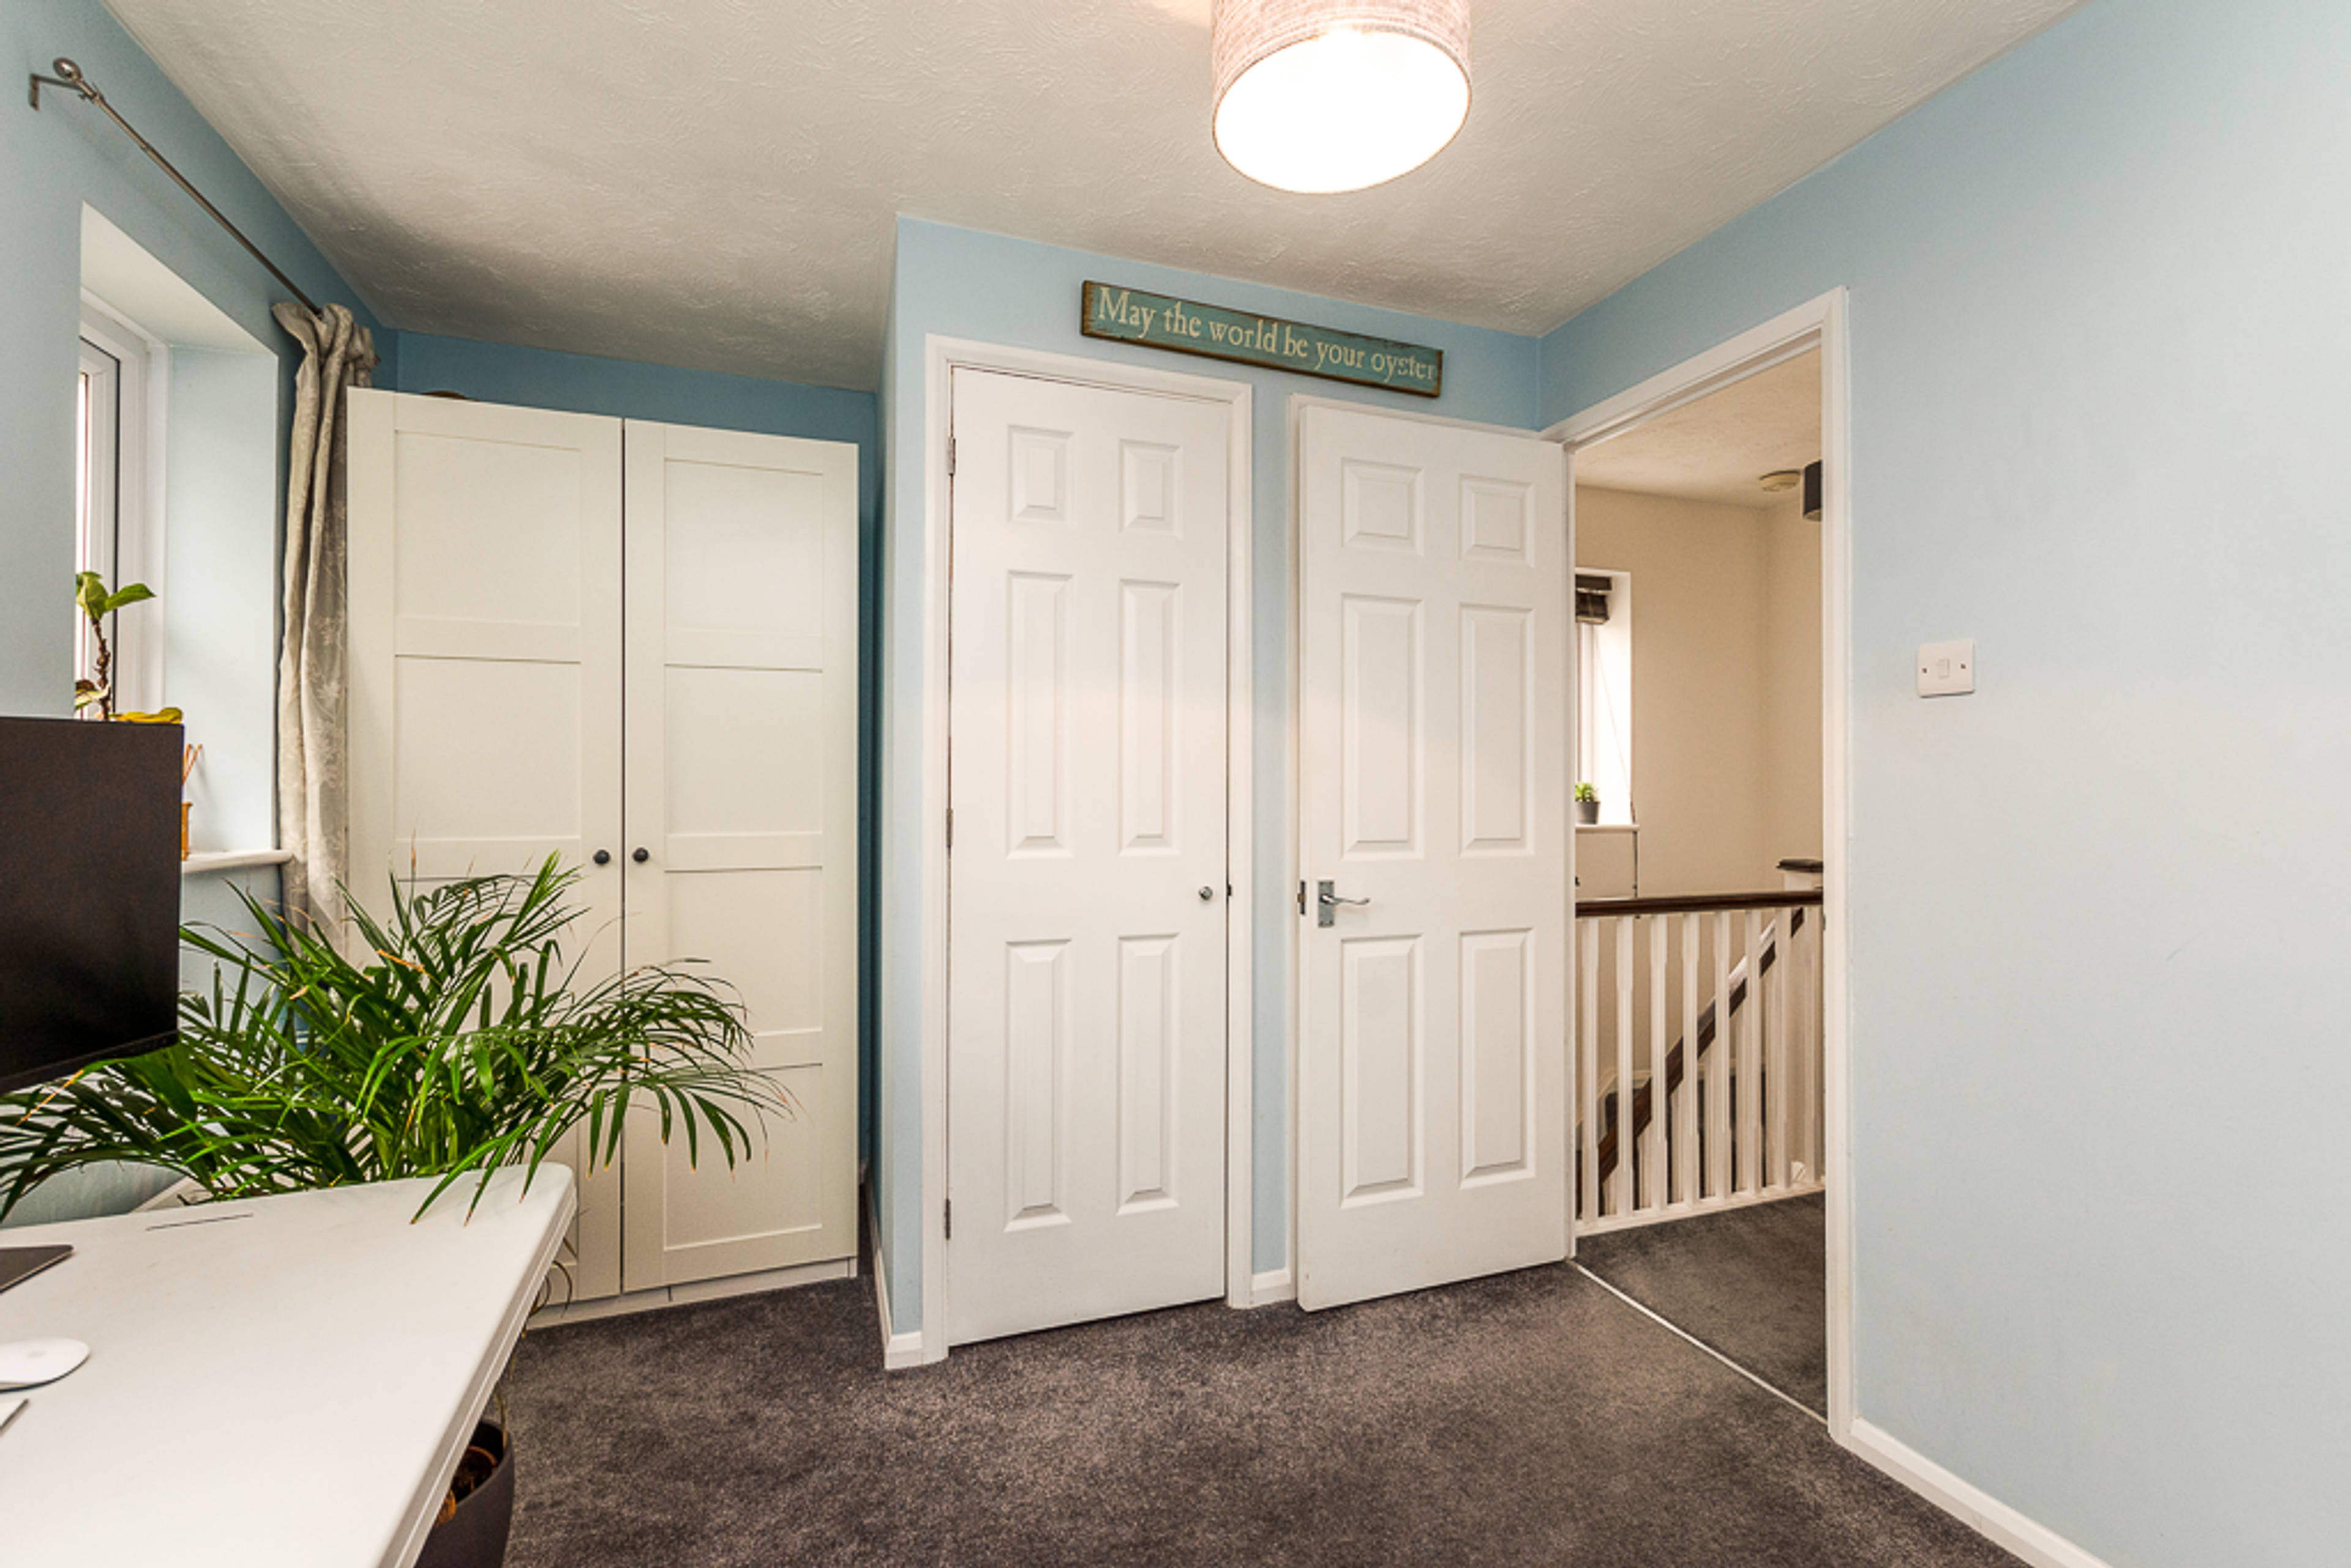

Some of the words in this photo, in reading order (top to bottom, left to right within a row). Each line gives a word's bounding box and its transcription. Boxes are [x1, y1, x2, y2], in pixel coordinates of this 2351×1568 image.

[1098, 287, 1156, 337] May
[1164, 301, 1201, 337] the
[1209, 319, 1277, 353] world
[1284, 327, 1308, 357] be
[1316, 340, 1364, 370] your
[1371, 352, 1436, 382] oyster
